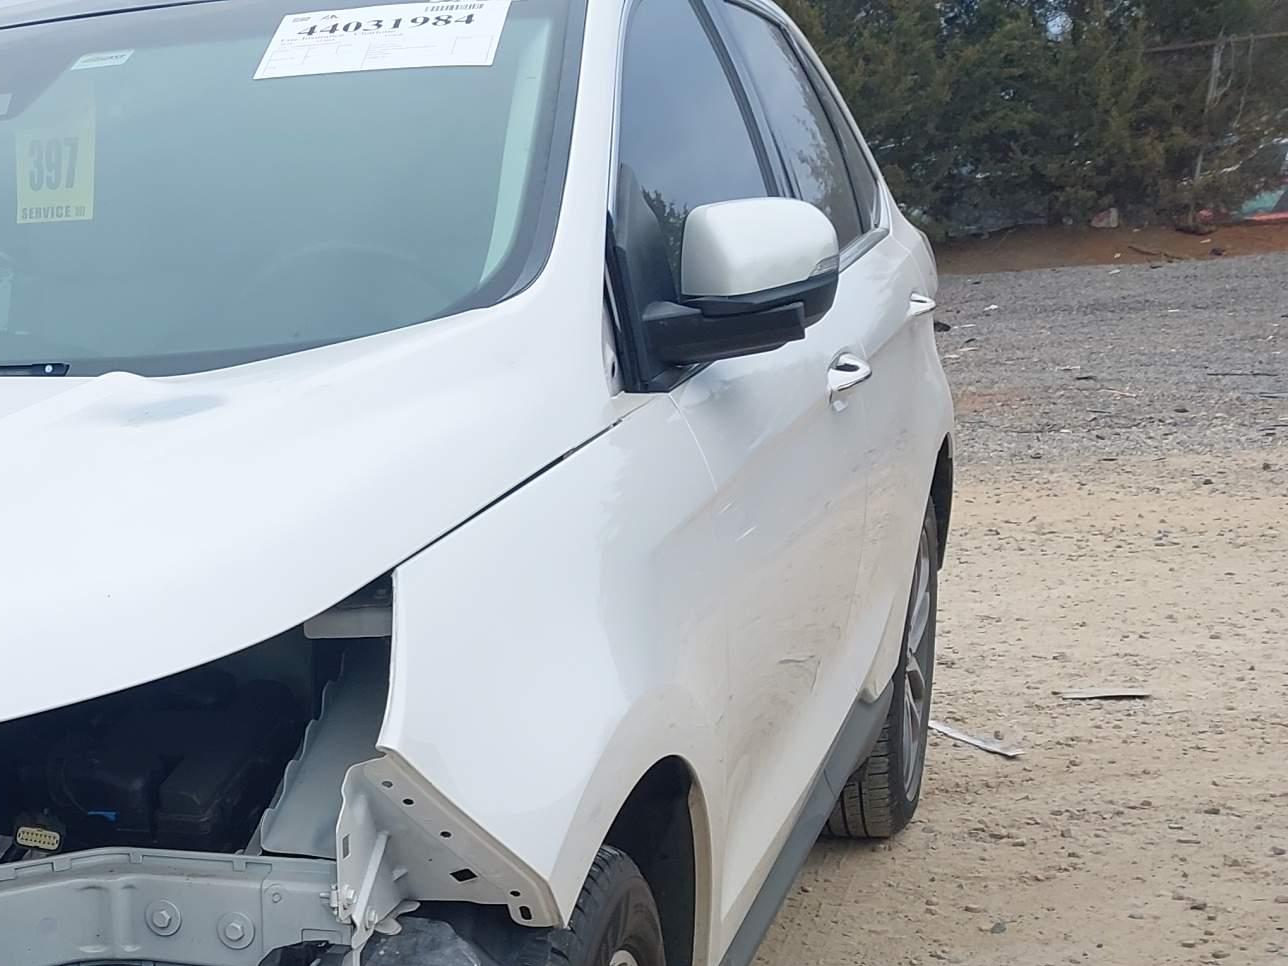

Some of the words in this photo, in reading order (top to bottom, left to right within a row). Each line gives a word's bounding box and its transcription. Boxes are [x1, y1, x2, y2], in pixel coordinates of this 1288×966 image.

[297, 13, 476, 36] 44031984
[28, 136, 80, 192] 397
[21, 205, 72, 220] SERVICE
